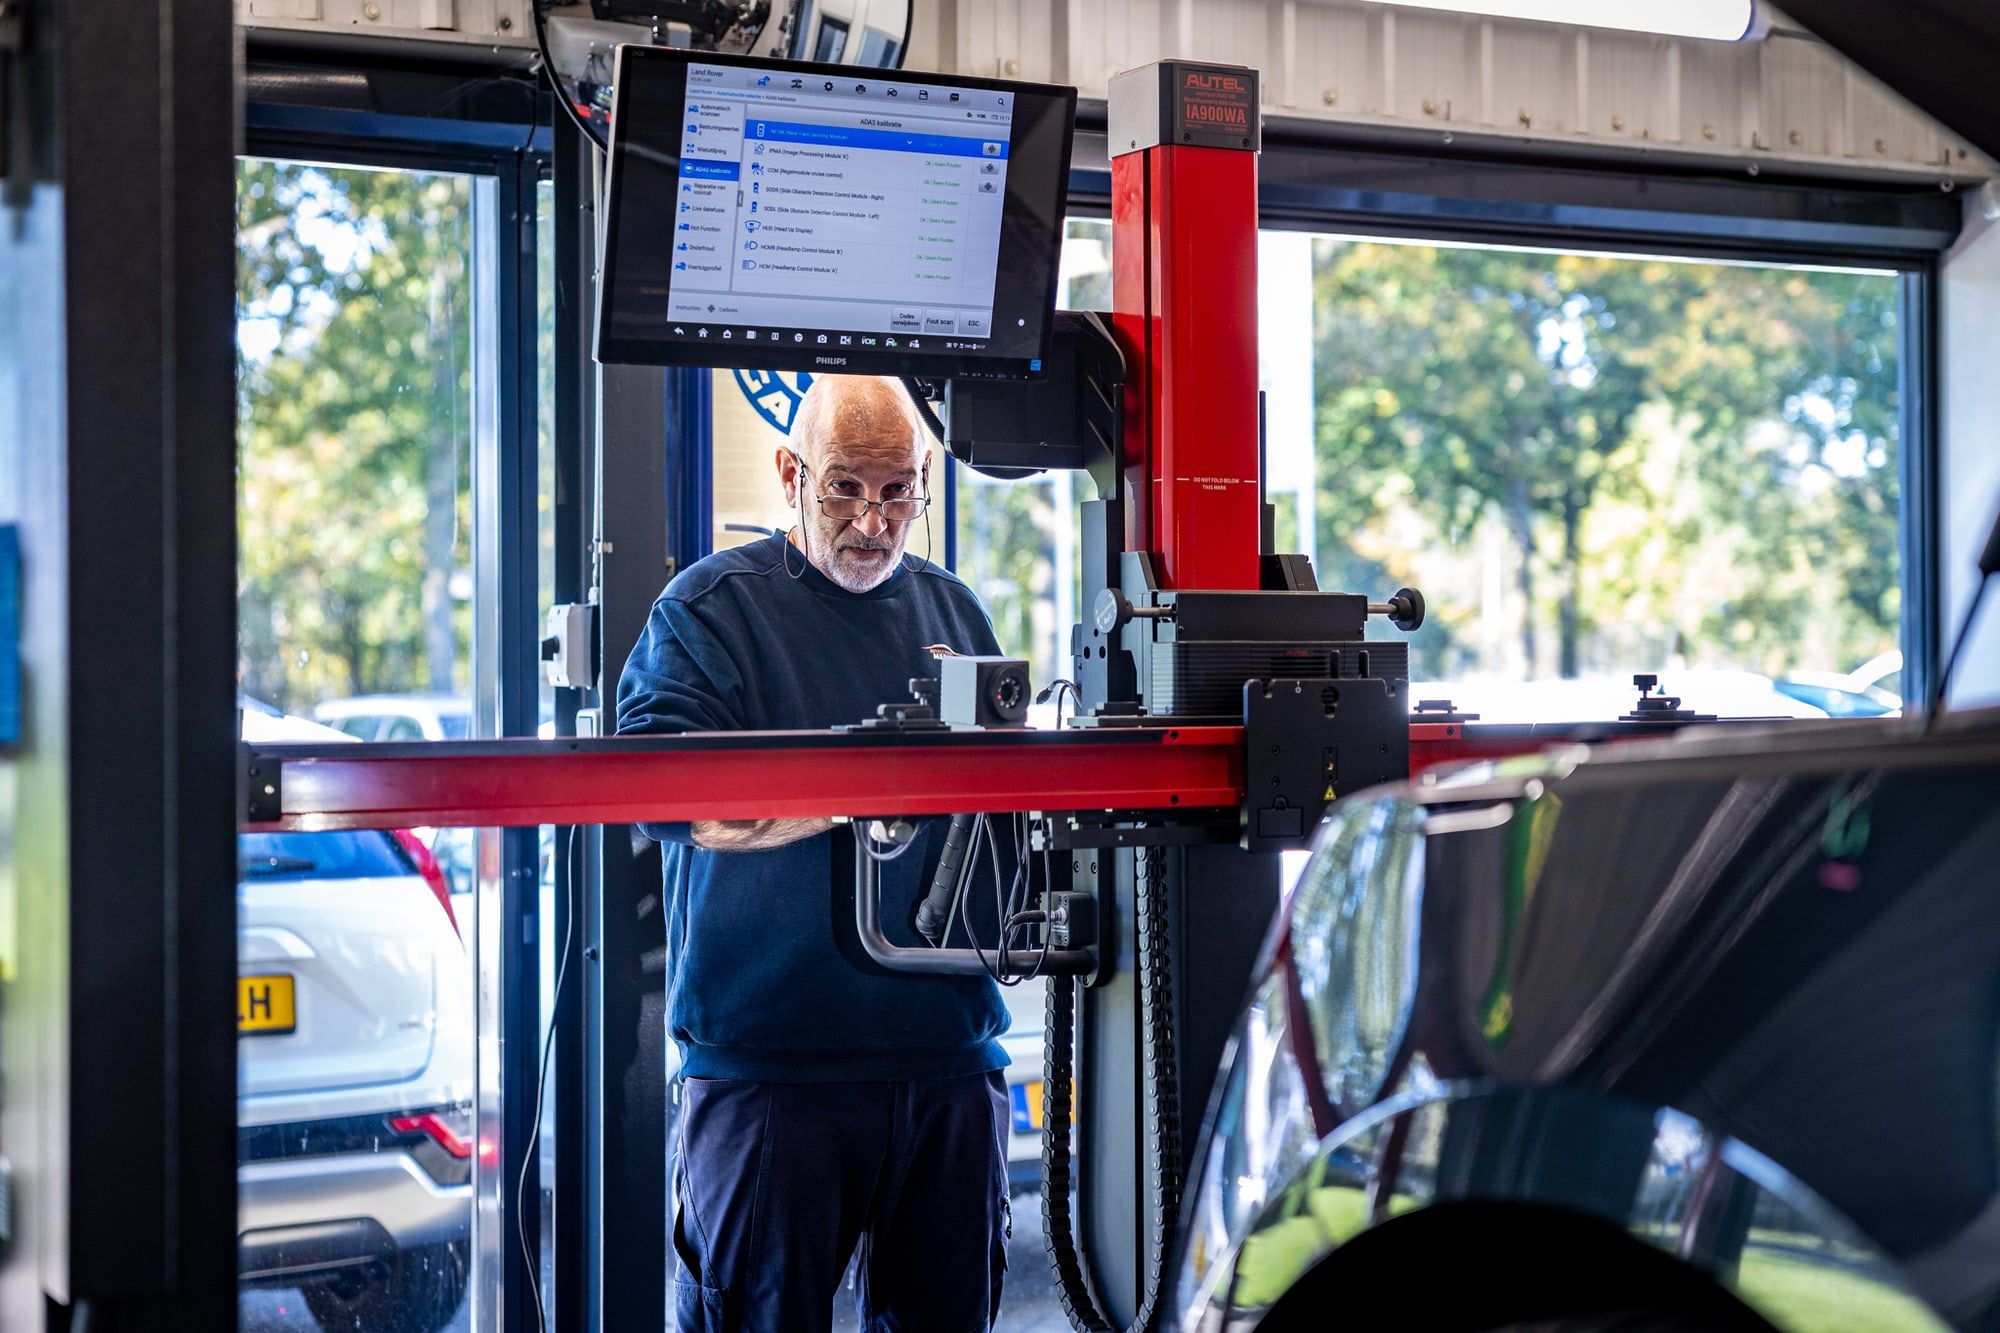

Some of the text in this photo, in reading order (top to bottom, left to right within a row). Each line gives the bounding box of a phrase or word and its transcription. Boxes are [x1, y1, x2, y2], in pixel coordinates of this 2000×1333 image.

[1187, 74, 1245, 92] AUTEL
[1186, 104, 1246, 124] IA900WA
[860, 118, 902, 128] ADAS kalibratie
[799, 150, 824, 158] Processing
[689, 244, 716, 252] Onderhoud
[776, 245, 800, 253] (Headlamp
[772, 264, 796, 272] (Headlamp
[899, 312, 915, 320] Codes
[816, 356, 847, 366] PHILIPS
